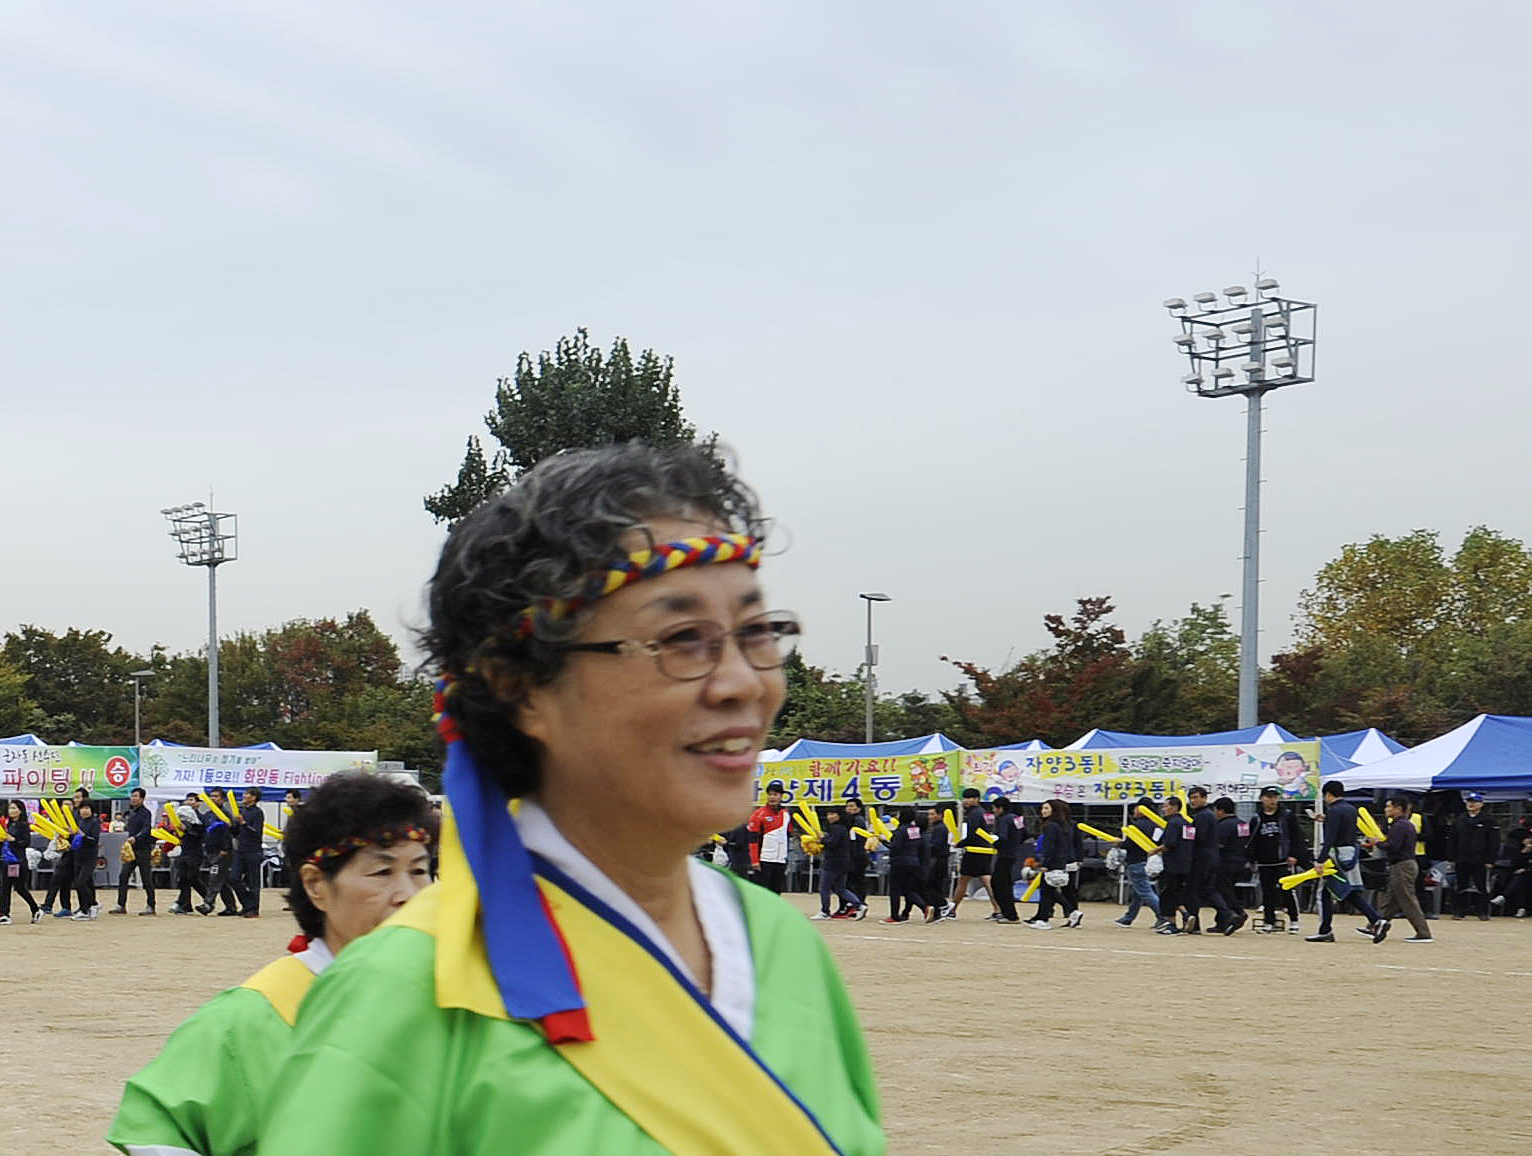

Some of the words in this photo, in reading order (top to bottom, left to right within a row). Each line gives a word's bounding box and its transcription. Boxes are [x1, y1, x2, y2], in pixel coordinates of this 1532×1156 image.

[109, 761, 129, 783] 승
[1025, 755, 1104, 774] 자양3동!
[2, 768, 71, 794] 파이팅
[244, 768, 280, 785] 화양동
[284, 771, 330, 786] Fightin
